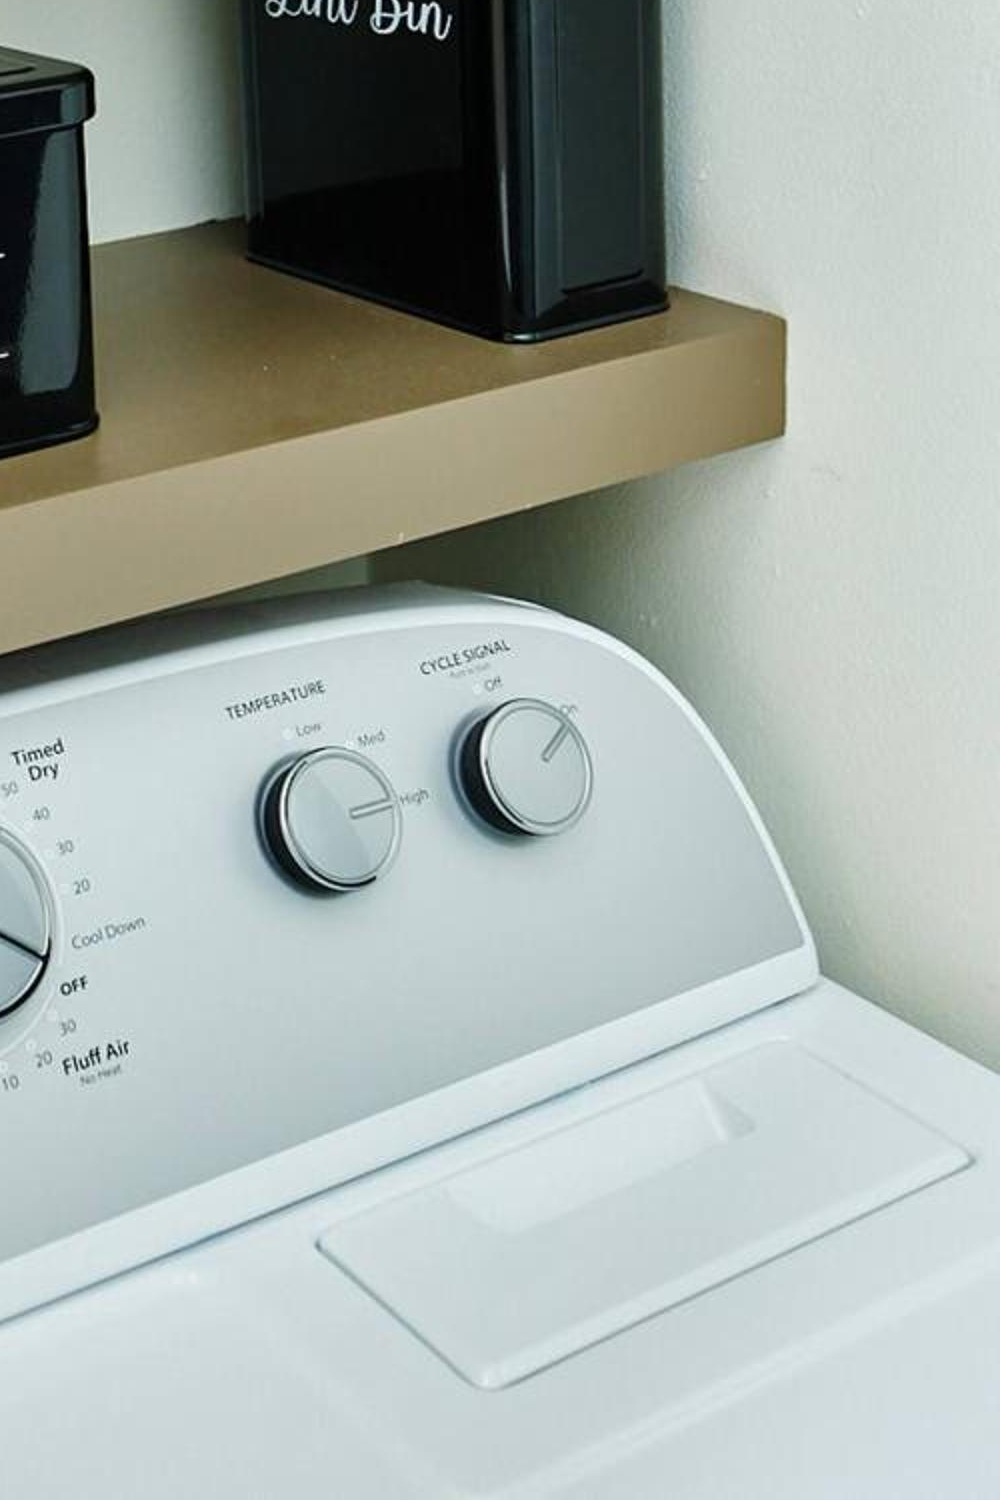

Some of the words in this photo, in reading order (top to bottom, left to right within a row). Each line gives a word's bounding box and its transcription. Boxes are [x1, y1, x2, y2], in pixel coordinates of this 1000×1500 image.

[420, 653, 462, 675] CYCLE
[462, 639, 511, 663] SIGNAL
[225, 680, 326, 720] TEMPERATURE
[296, 722, 321, 737] Low
[358, 729, 385, 748] Med
[11, 738, 65, 766] Timed
[28, 760, 59, 782] Dry
[1, 781, 18, 797] 50
[400, 787, 429, 808] High
[33, 806, 50, 820] 40
[56, 840, 74, 855] 30
[73, 878, 90, 895] 20
[71, 927, 102, 949] Cool
[104, 916, 146, 940] Down
[60, 975, 88, 996] OFF
[60, 1019, 76, 1037] 30
[35, 1051, 53, 1068] 20
[62, 1046, 103, 1076] Fluff
[106, 1038, 130, 1061] Air
[2, 1074, 19, 1090] 10
